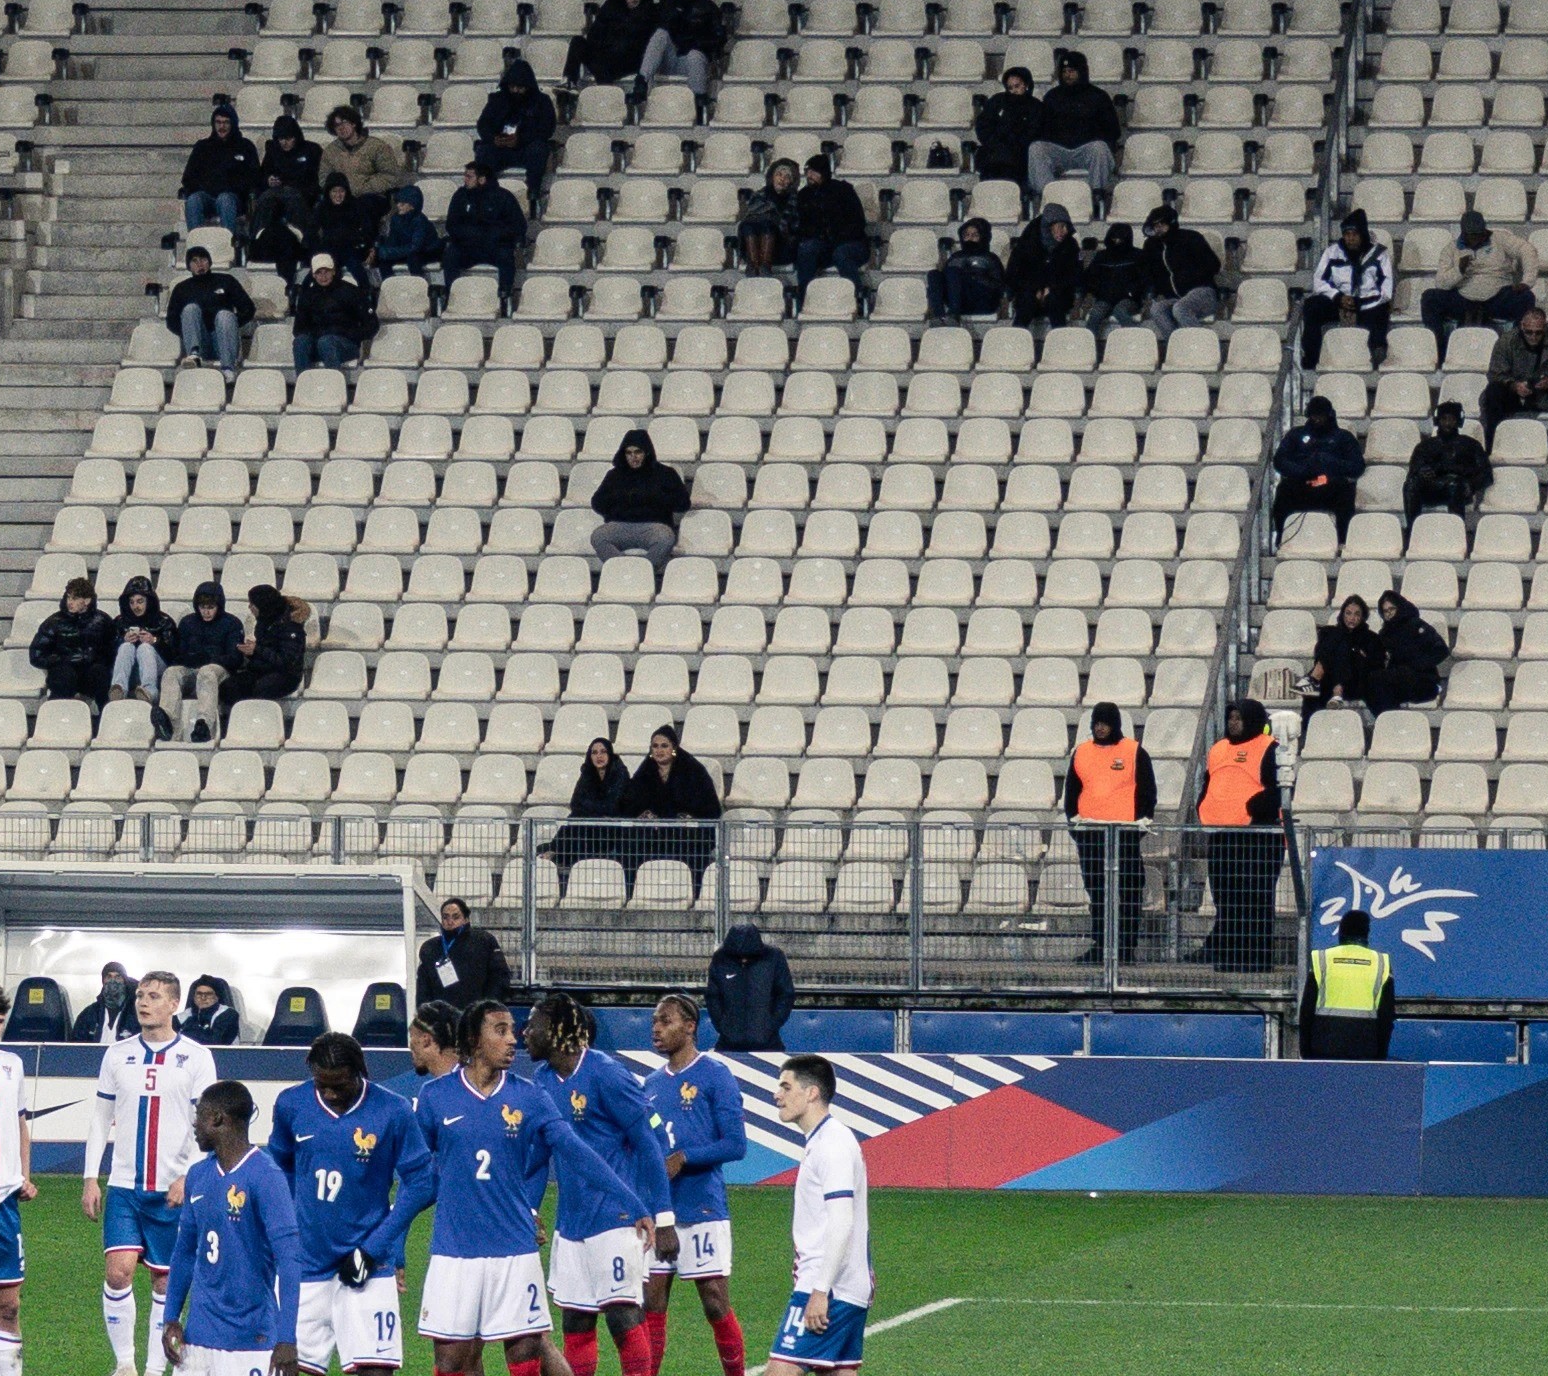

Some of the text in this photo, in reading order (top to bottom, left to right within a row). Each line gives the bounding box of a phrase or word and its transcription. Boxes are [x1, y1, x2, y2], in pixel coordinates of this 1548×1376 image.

[145, 1068, 157, 1091] 5
[475, 1149, 491, 1180] 2
[315, 1168, 343, 1203] 19
[206, 1230, 219, 1265] 3
[692, 1232, 715, 1258] 14
[612, 1256, 625, 1282] 8
[527, 1283, 540, 1312] 2
[374, 1310, 396, 1341] 19
[783, 1305, 806, 1337] 14
